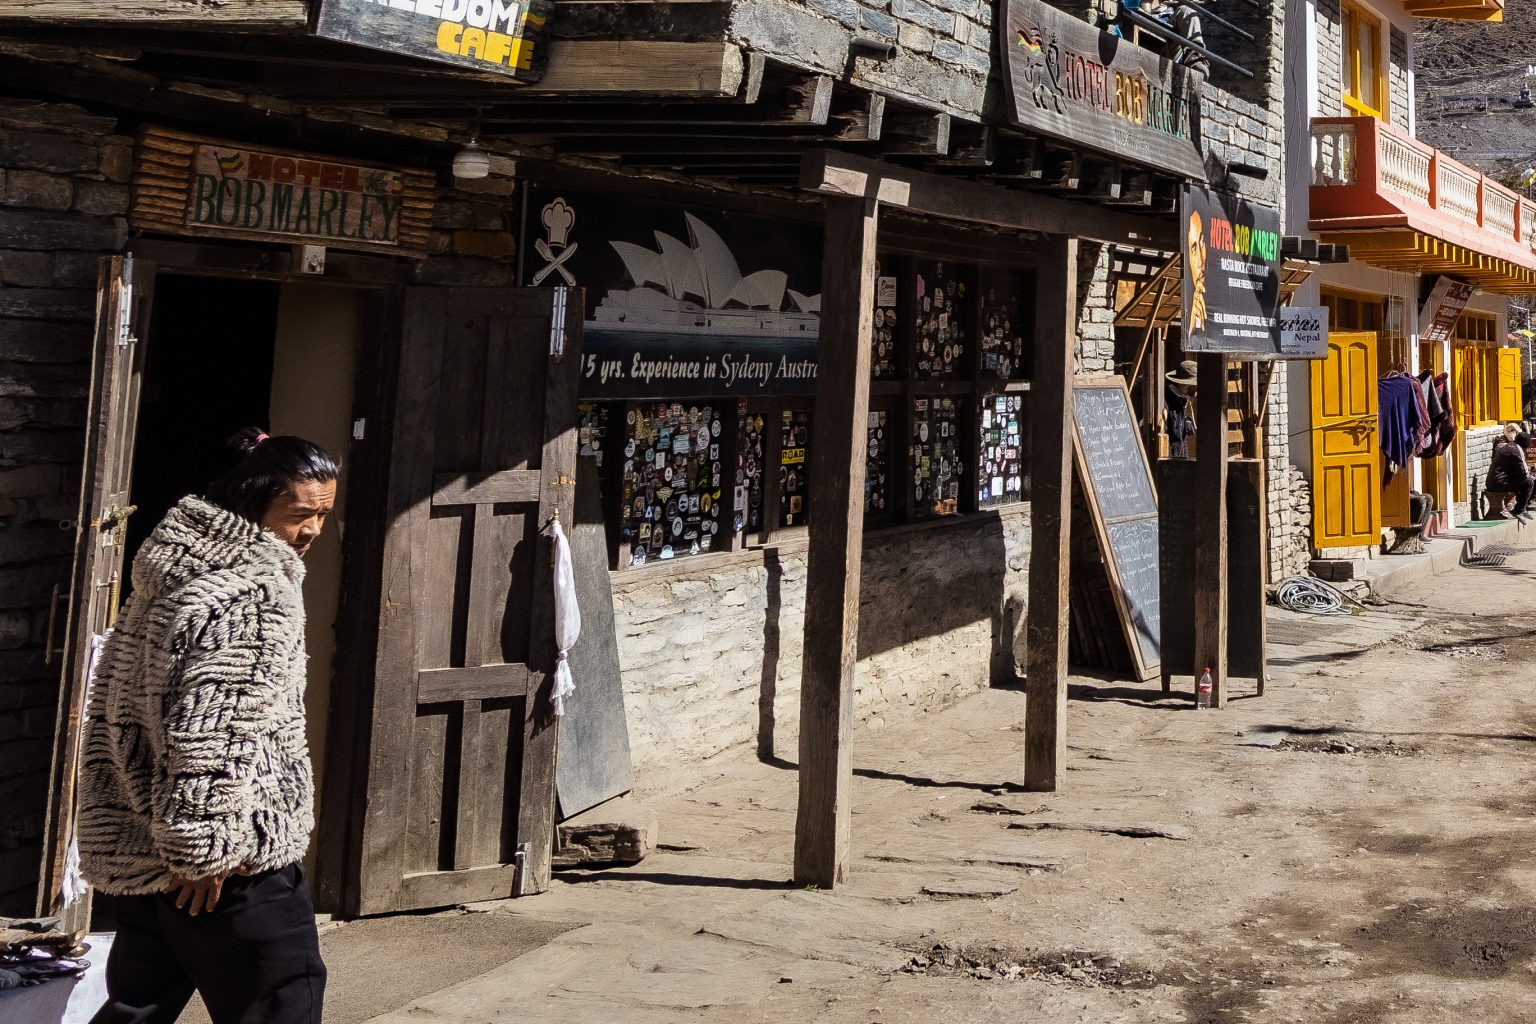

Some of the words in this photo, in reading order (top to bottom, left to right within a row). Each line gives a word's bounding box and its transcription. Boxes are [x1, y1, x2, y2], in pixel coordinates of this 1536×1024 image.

[436, 21, 535, 70] CAFE
[1065, 51, 1112, 113] HOTEL
[1116, 71, 1143, 124] BOB
[248, 153, 363, 192] HOTEL
[194, 173, 266, 228] BOB
[269, 182, 400, 242] MARLEY
[1210, 217, 1233, 252] HOTEL
[1235, 224, 1249, 255] BOB
[1251, 228, 1278, 261] MARLEY
[1294, 333, 1320, 343] Nepal
[600, 360, 625, 384] yrs.
[631, 352, 700, 384] Experience
[703, 355, 717, 378] in
[720, 353, 773, 387] Sydeny
